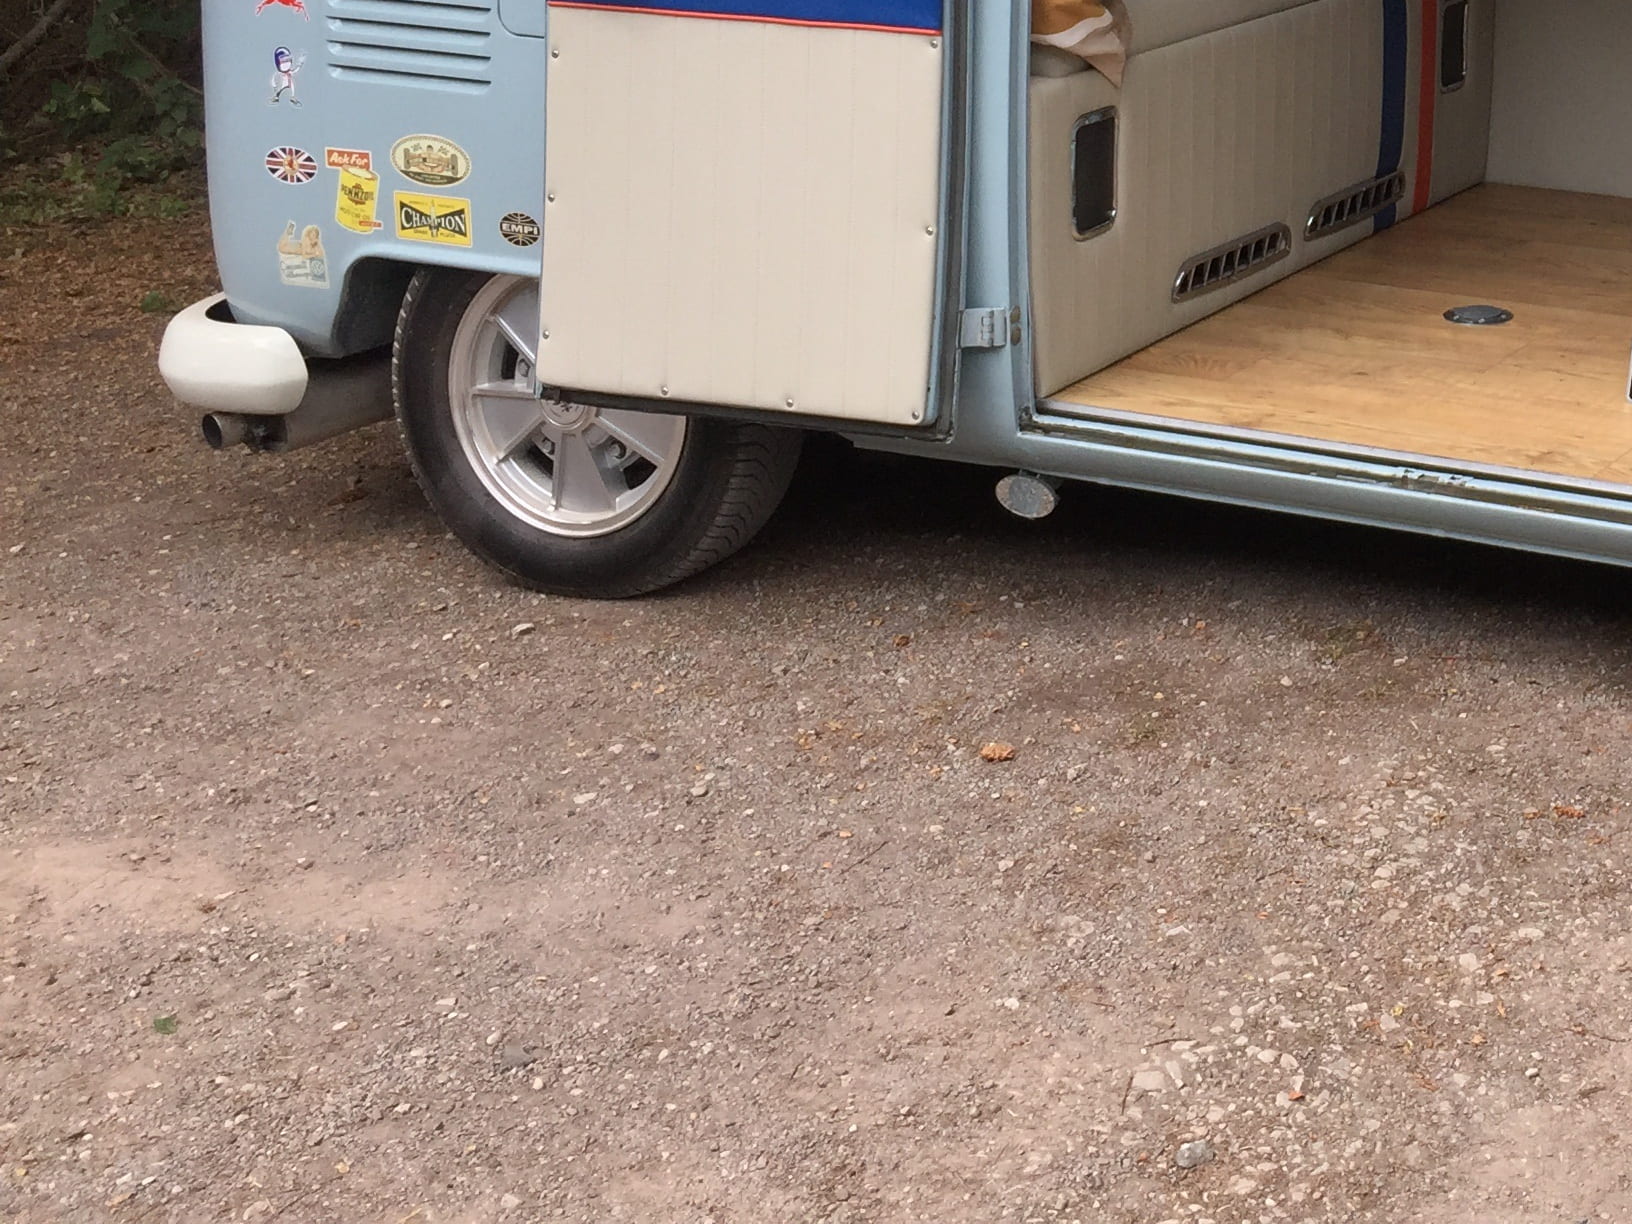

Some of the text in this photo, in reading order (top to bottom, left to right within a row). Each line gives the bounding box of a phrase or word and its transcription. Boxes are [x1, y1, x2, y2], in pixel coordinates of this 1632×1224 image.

[329, 151, 368, 166] Ask For
[502, 222, 539, 235] EMPI
